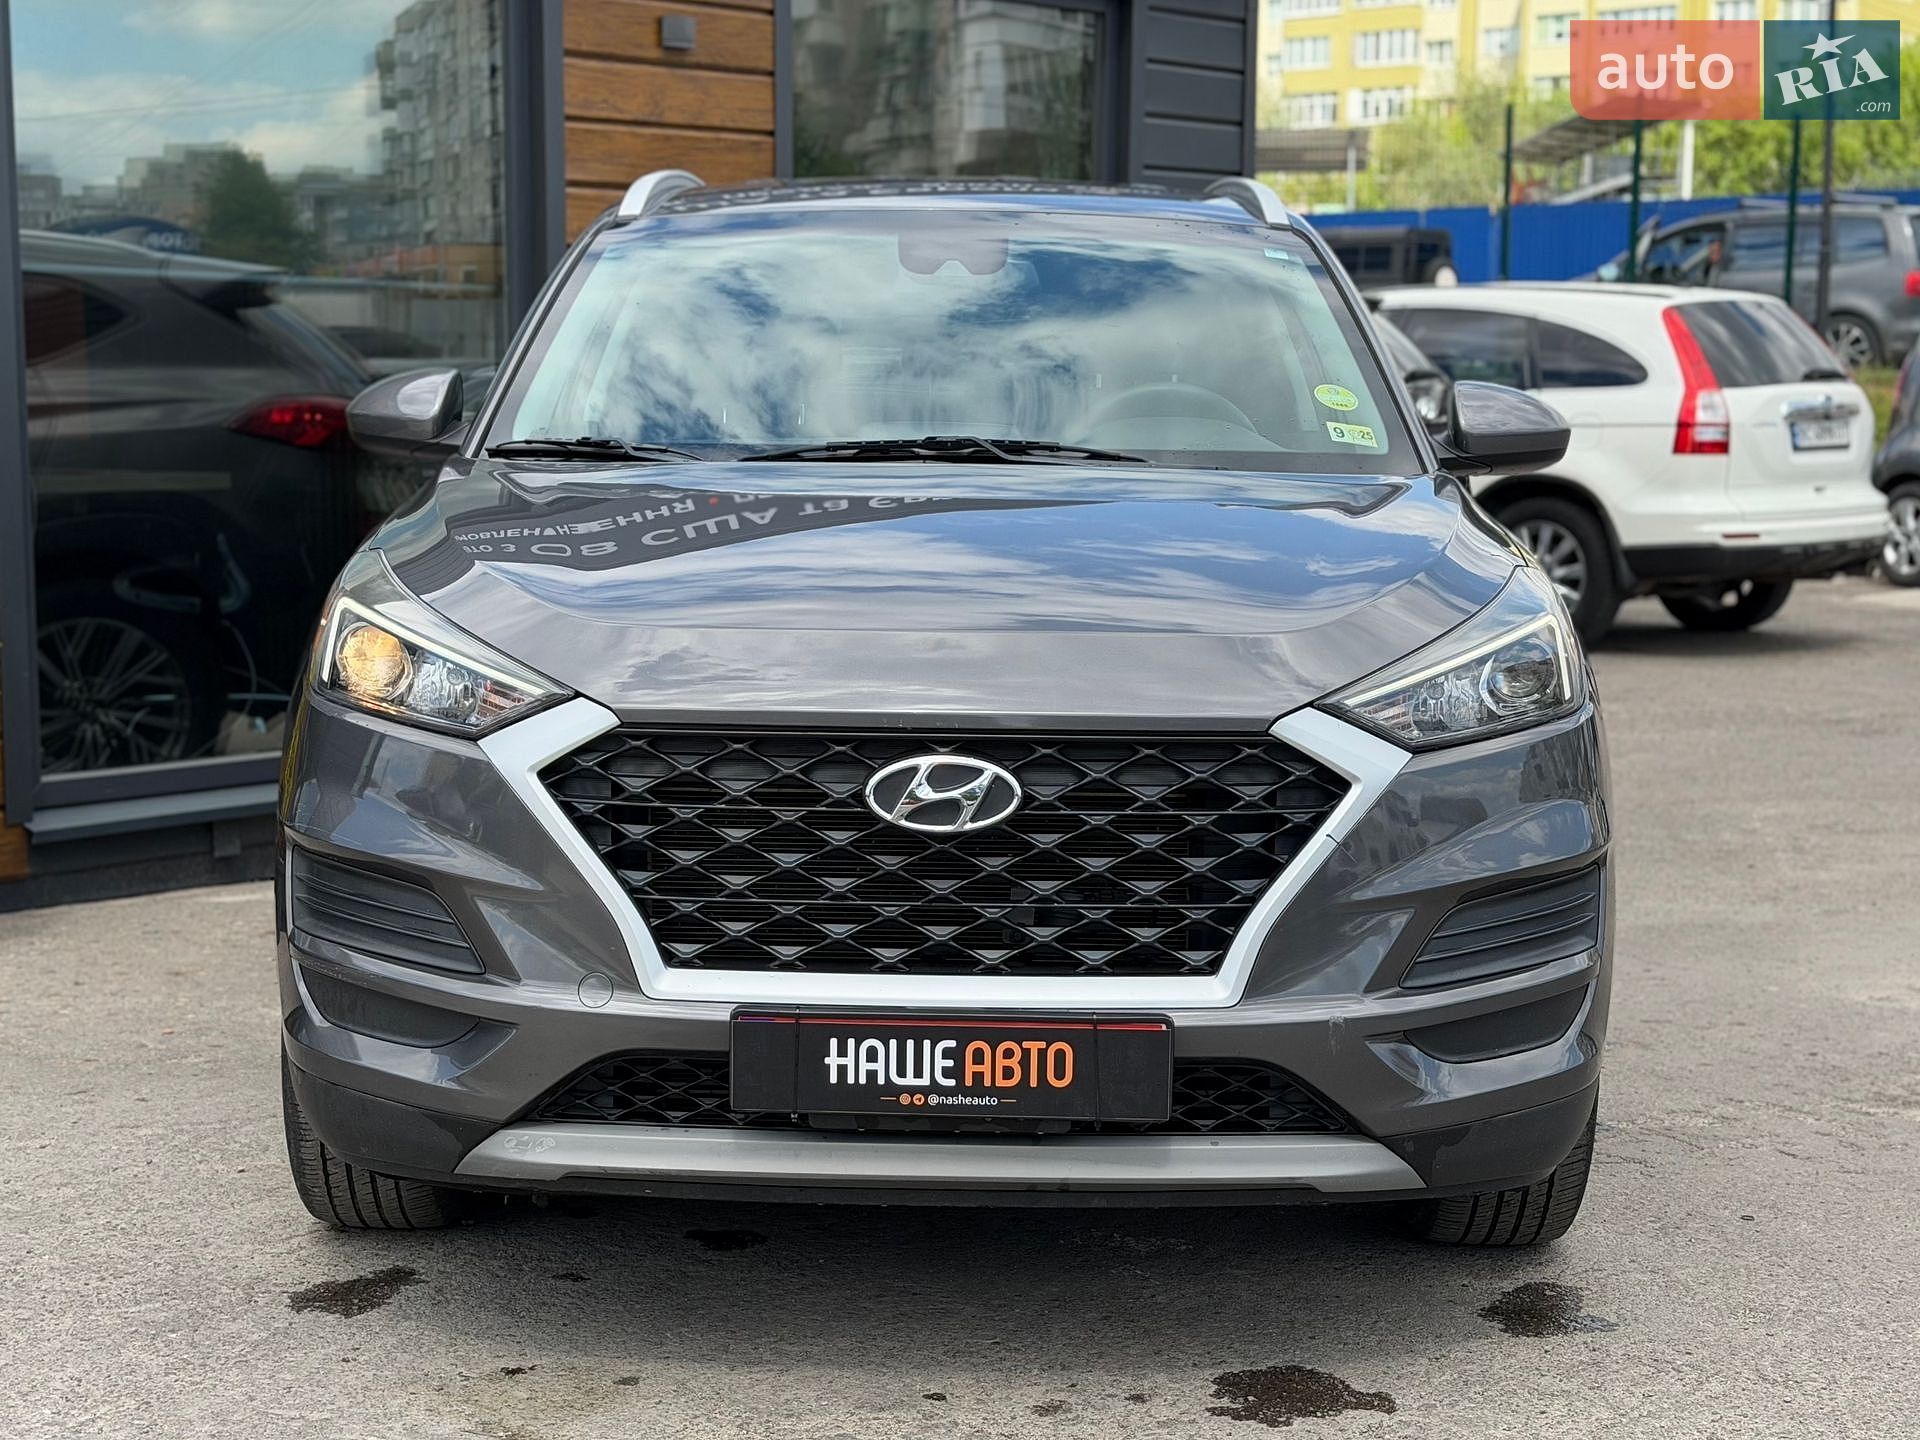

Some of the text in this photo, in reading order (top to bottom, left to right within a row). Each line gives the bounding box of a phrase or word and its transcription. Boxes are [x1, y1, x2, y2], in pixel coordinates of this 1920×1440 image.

[1333, 426, 1346, 439] 9
[824, 1037, 1075, 1088] НАШЕ АВТО
[927, 1093, 999, 1107] @nasheauto
